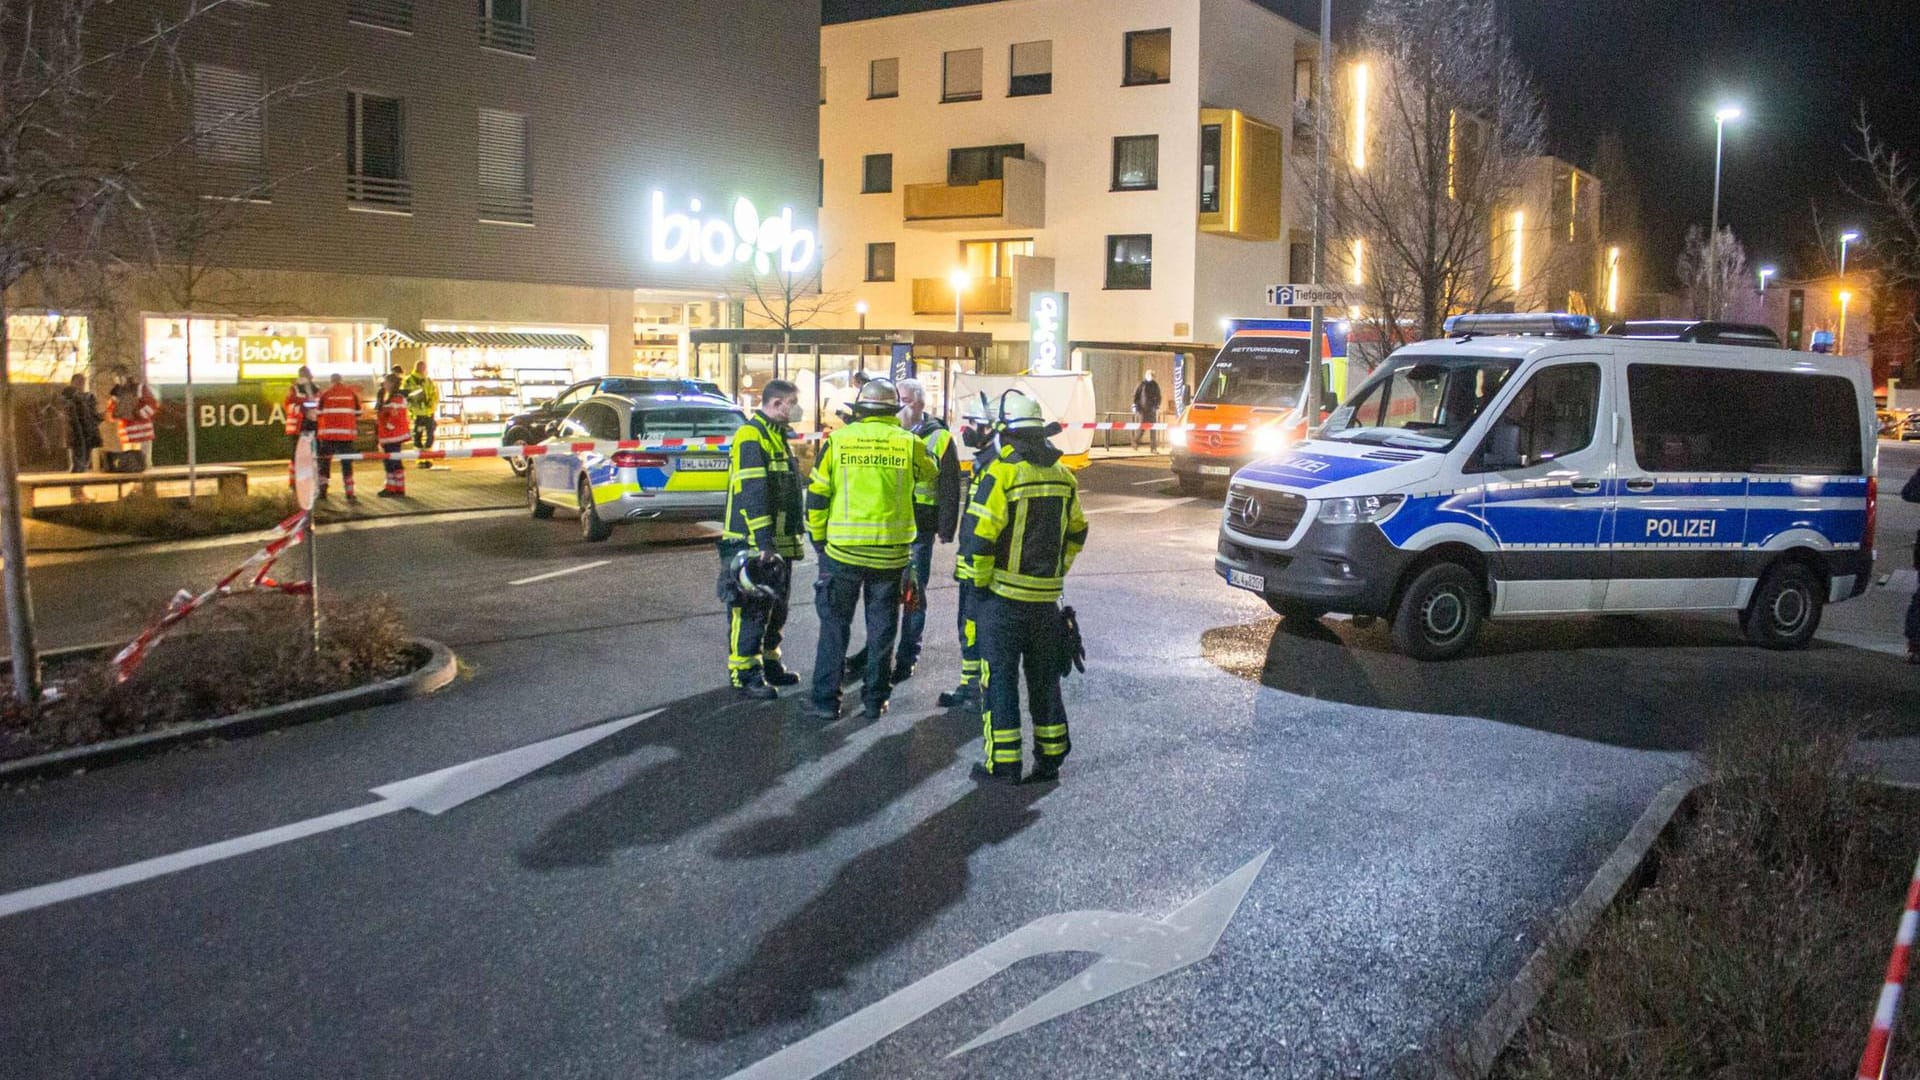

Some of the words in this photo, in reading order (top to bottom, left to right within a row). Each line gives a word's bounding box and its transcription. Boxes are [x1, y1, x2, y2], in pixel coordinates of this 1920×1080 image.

[200, 402, 286, 427] BIOLA
[840, 453, 906, 466] Einsatzleiter
[1646, 519, 1716, 537] POLIZEI
